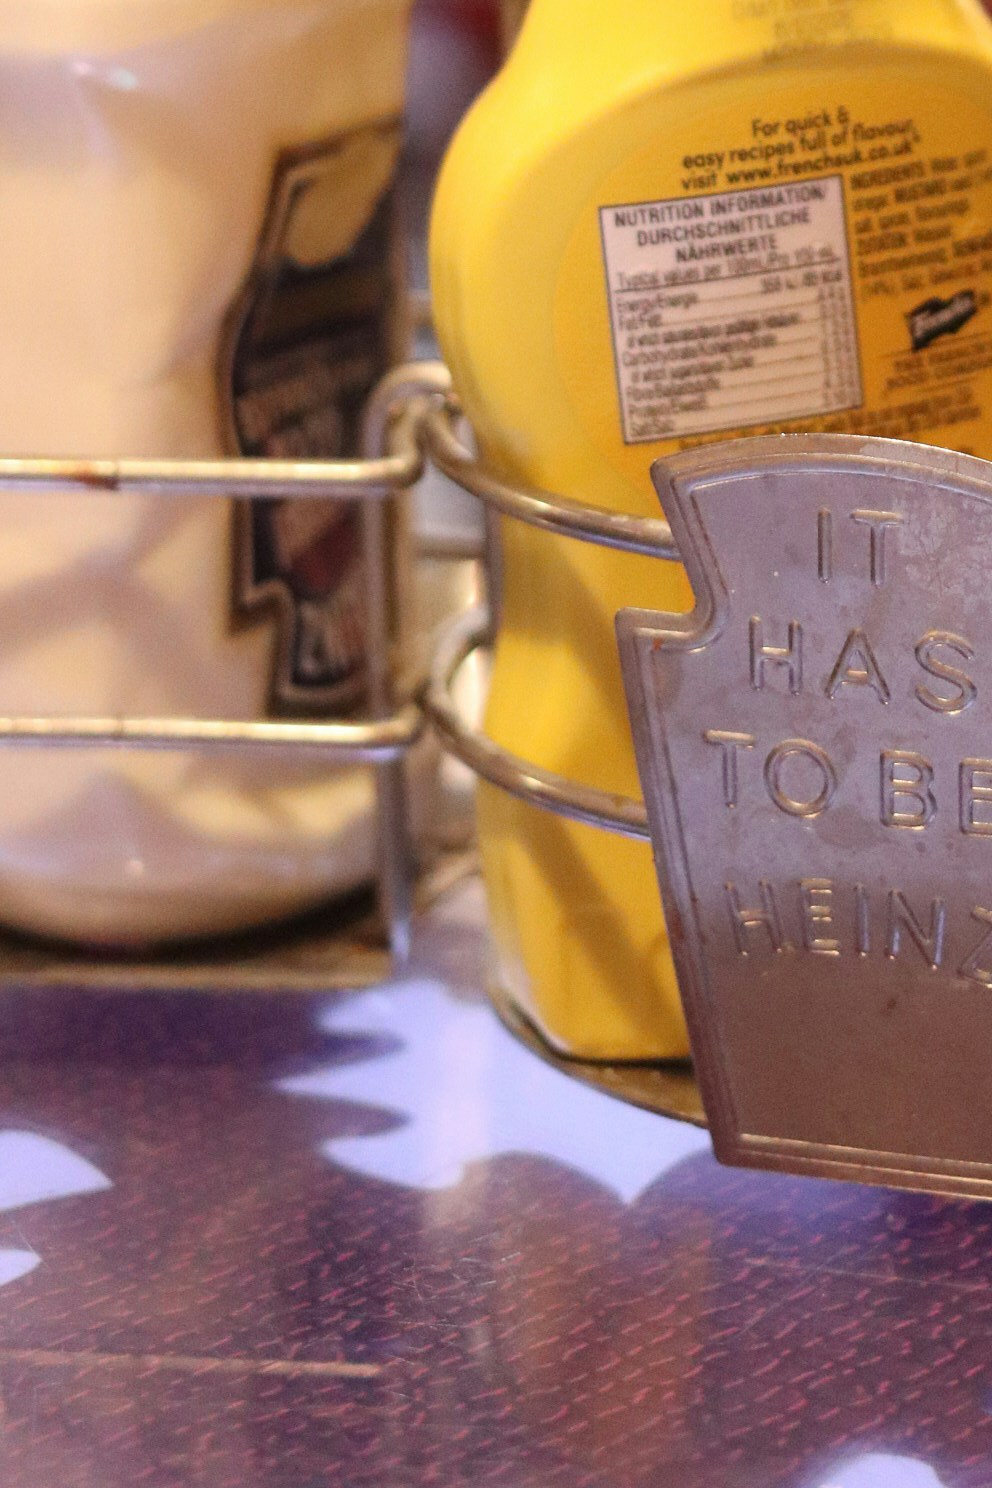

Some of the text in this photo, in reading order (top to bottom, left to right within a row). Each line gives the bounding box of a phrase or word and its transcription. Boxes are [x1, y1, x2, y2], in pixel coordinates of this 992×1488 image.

[752, 117, 780, 137] For
[785, 109, 832, 136] quick
[682, 150, 725, 170] easy
[729, 140, 795, 164] recipes
[799, 129, 827, 152] full
[831, 124, 849, 147] of
[681, 168, 717, 190] visit
[614, 202, 705, 228] NUTRITION
[636, 206, 811, 247] DURCHSCHNITTLICHE
[816, 506, 904, 587] IT
[748, 614, 979, 716] HAS
[703, 728, 840, 818] TO
